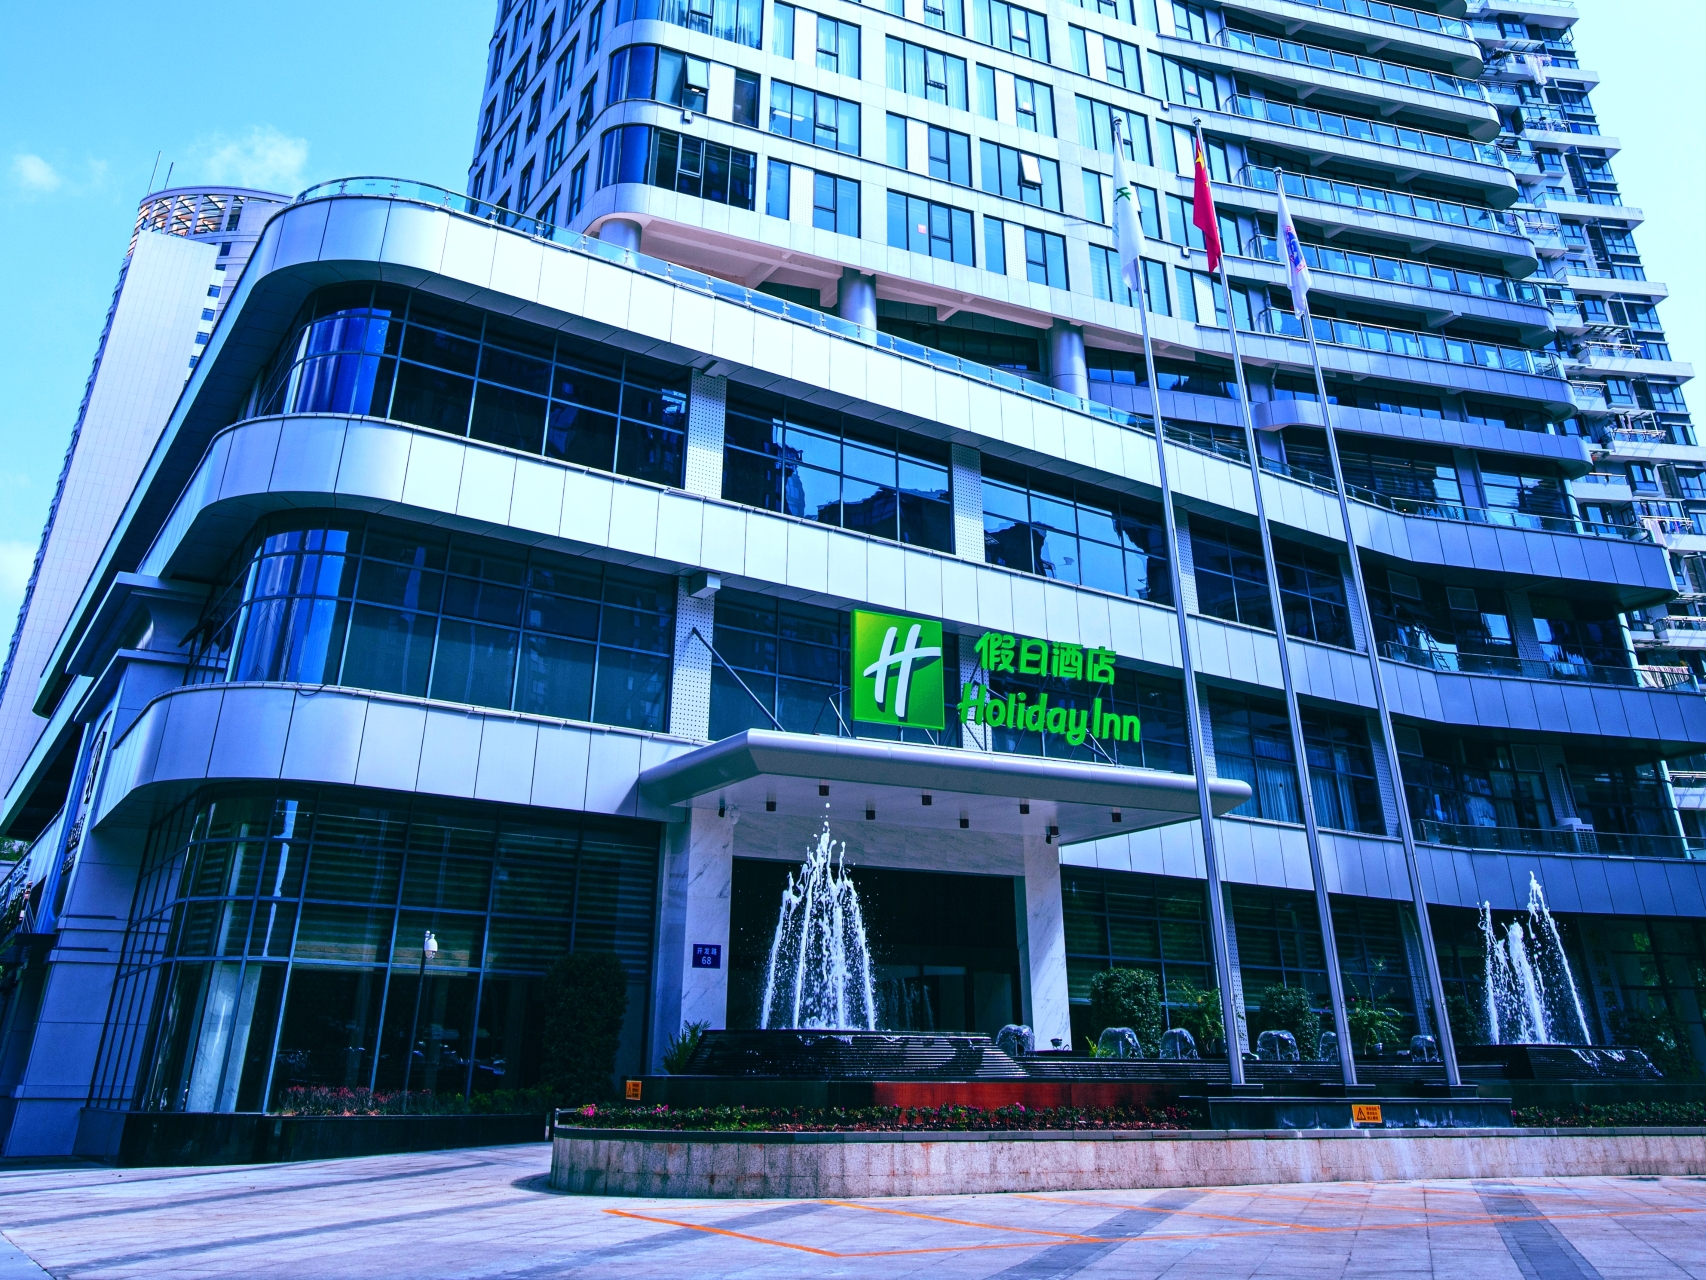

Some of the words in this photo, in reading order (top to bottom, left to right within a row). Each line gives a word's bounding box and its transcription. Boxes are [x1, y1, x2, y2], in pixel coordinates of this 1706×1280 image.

[974, 631, 1117, 685] 假日酒店
[956, 682, 1088, 746] Holiday
[1093, 698, 1141, 743] Inn
[696, 947, 717, 955] 开发路
[701, 956, 712, 965] 68
